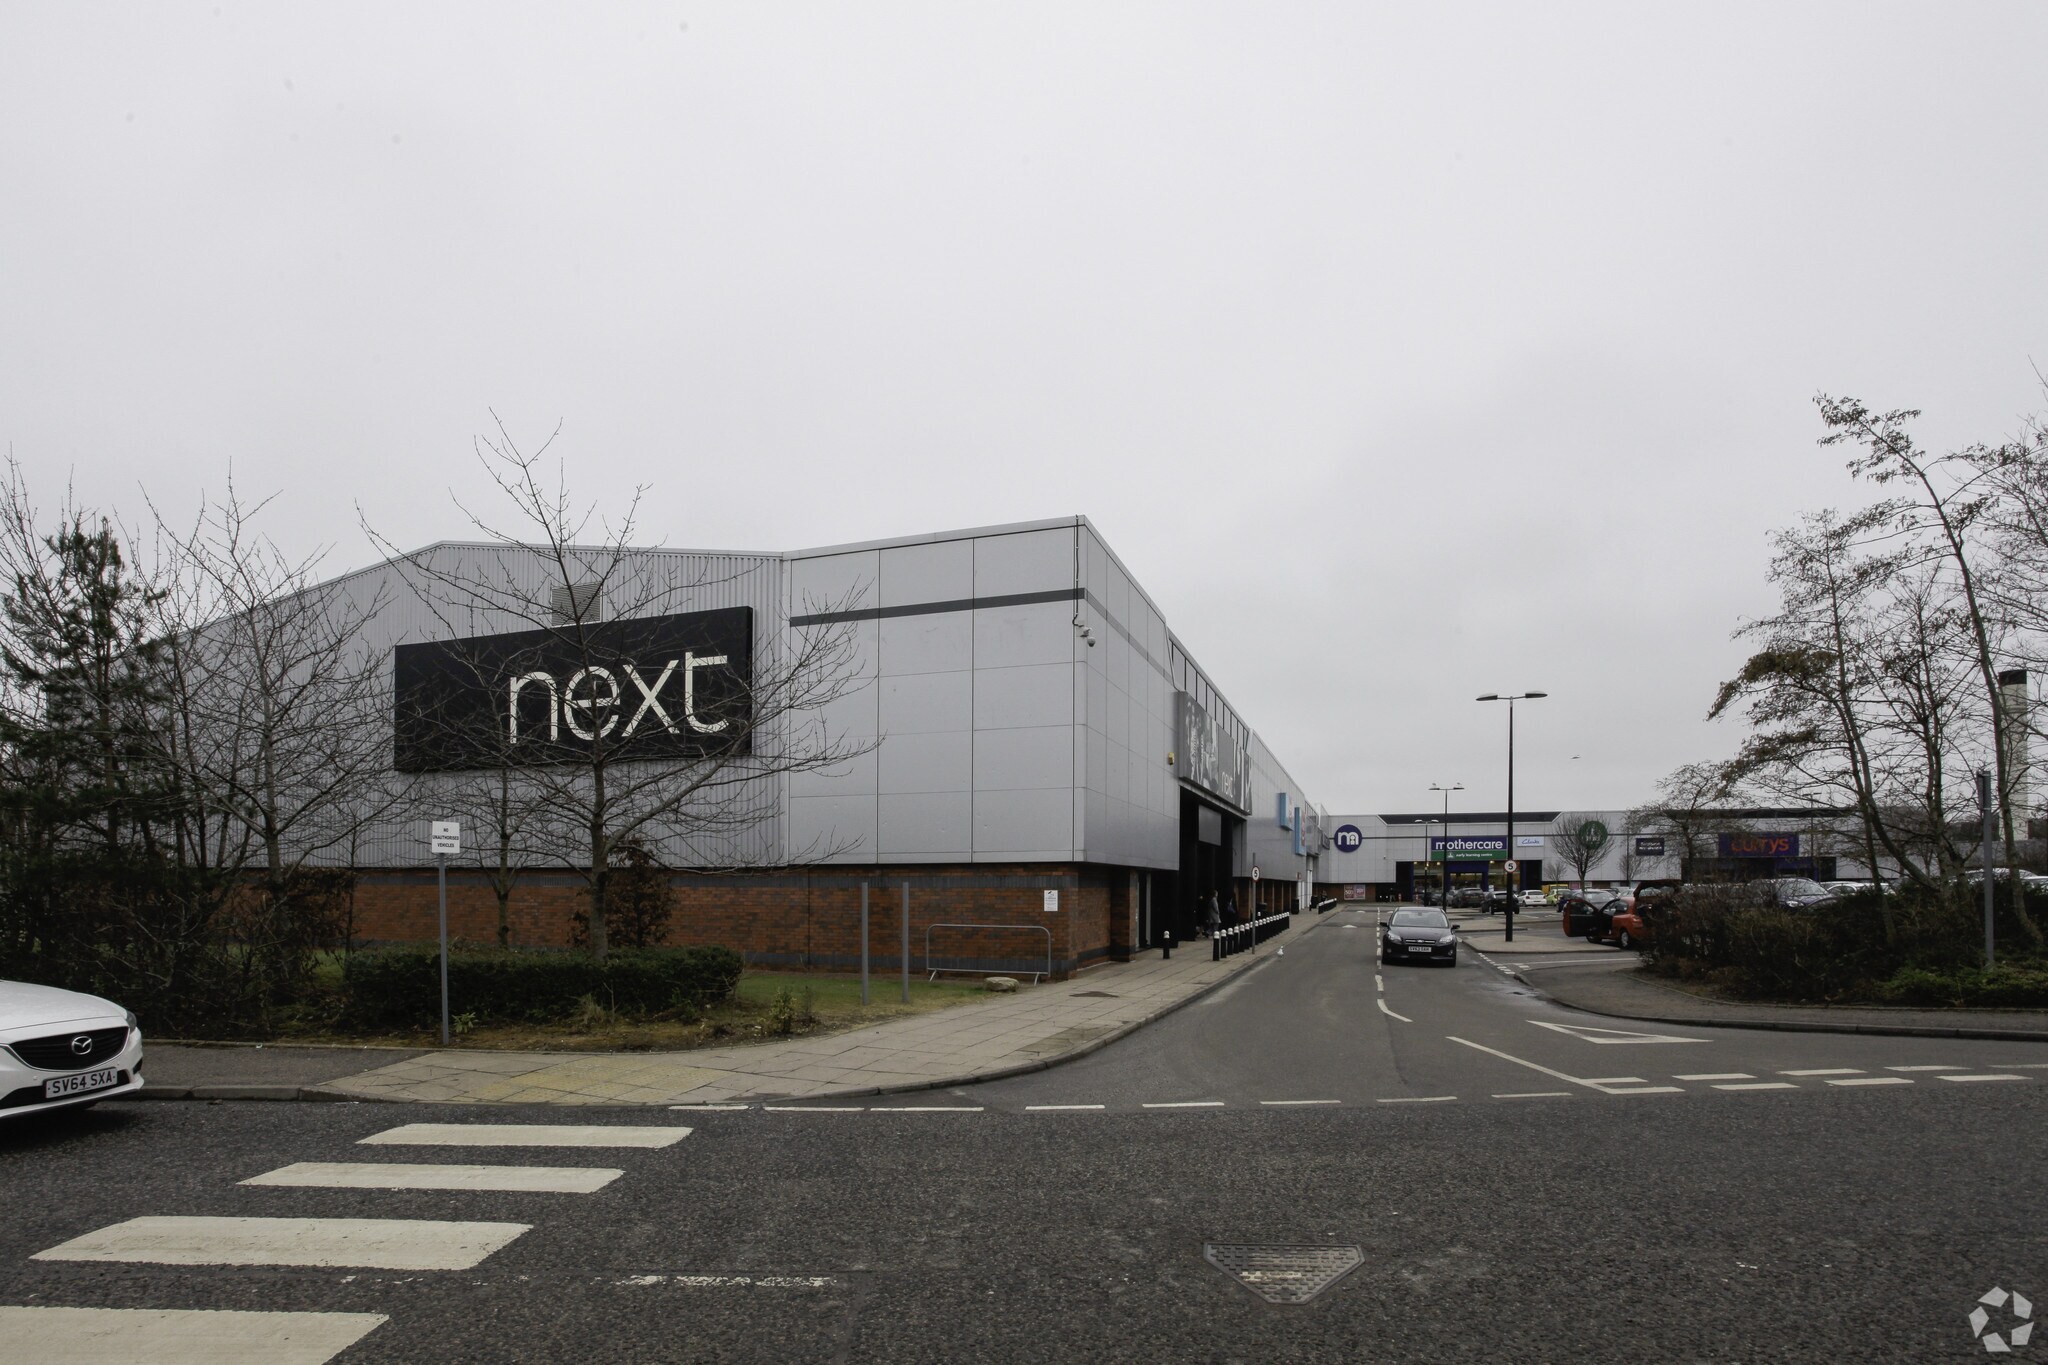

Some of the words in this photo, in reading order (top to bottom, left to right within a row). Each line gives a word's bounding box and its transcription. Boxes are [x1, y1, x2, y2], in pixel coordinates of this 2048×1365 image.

[510, 651, 729, 744] next
[1435, 839, 1503, 850] mothercare
[52, 1075, 87, 1094] SV64
[90, 1070, 112, 1086] SXA
